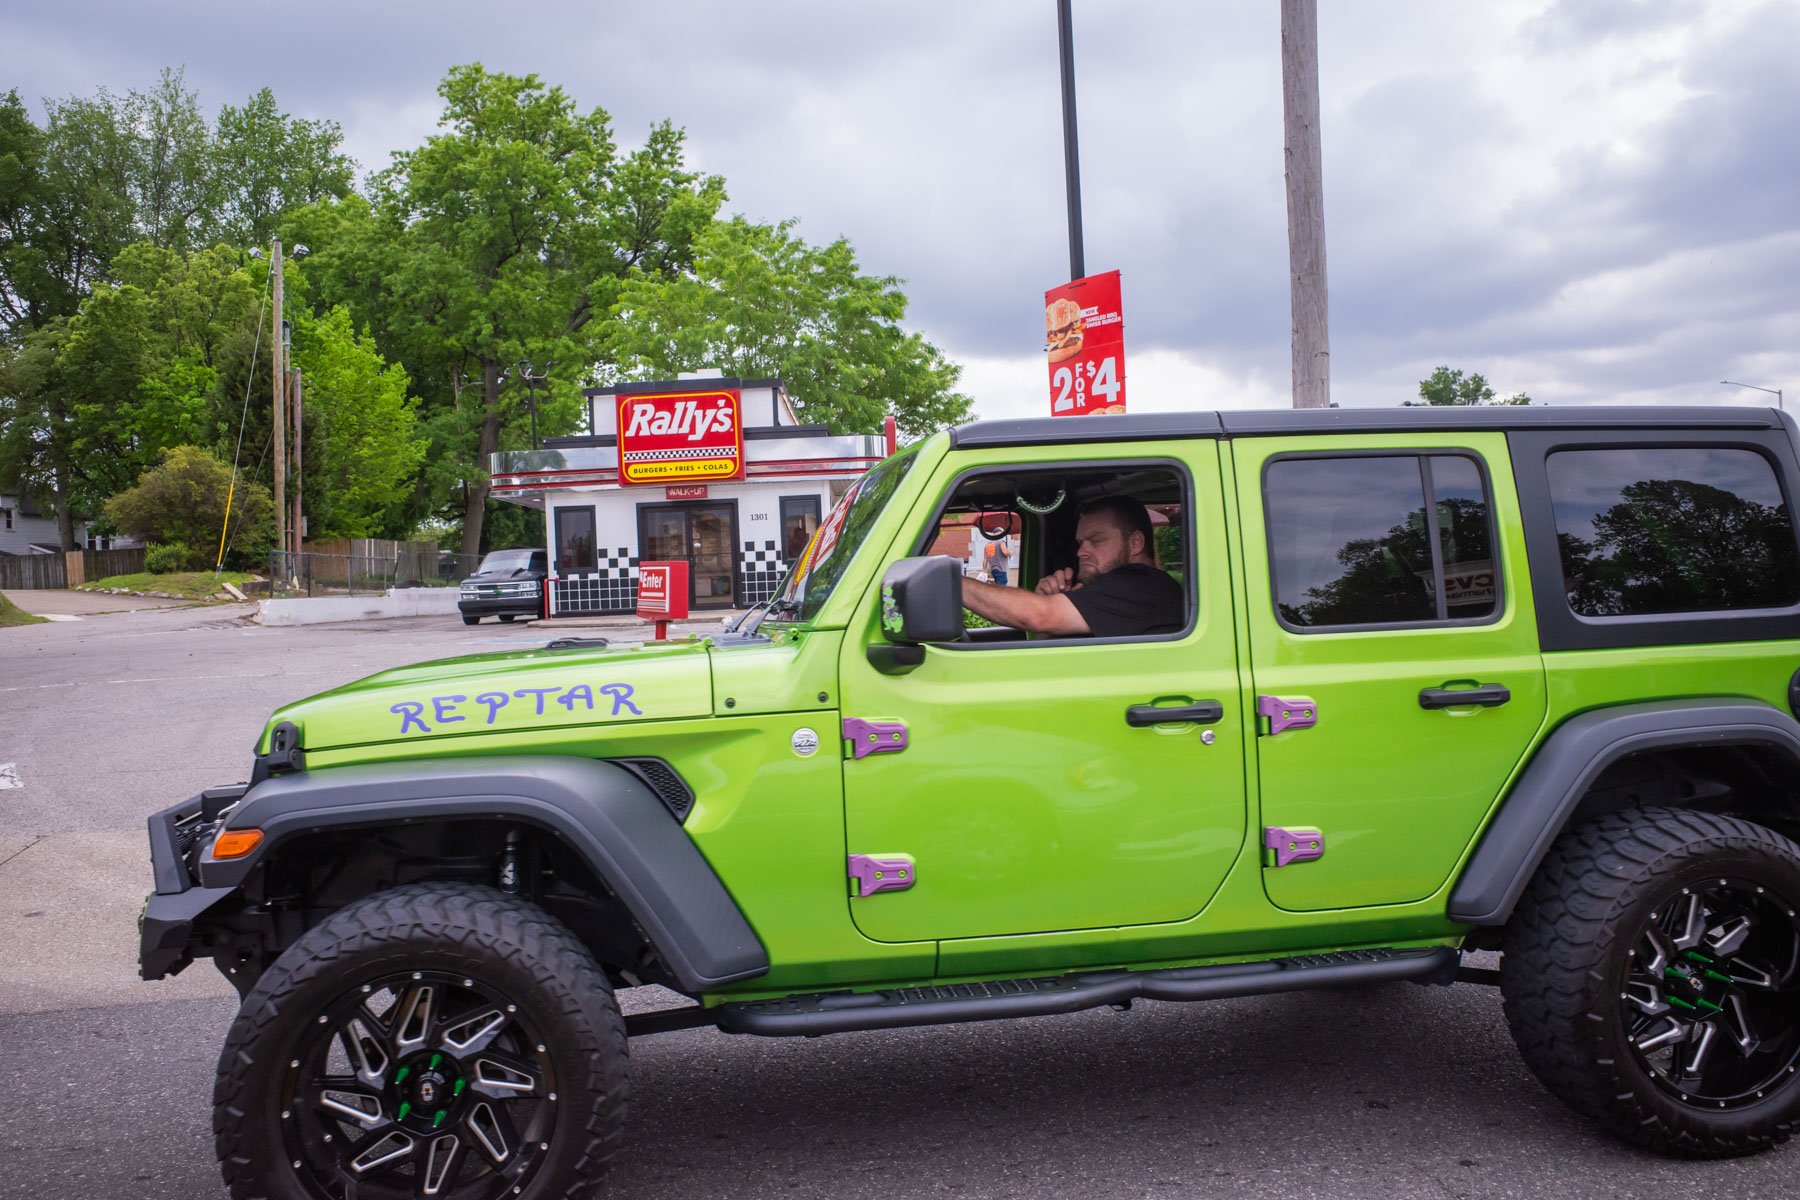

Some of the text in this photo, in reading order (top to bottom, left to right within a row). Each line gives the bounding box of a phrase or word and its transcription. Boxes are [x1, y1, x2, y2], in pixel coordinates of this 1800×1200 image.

[1053, 356, 1121, 413] 2 FOR $4
[625, 399, 734, 441] Rally's
[633, 466, 667, 474] BURGERS
[703, 463, 729, 471] COLAS
[668, 487, 705, 496] WALK-UP
[750, 513, 768, 521] 1301
[642, 571, 663, 589] Enter
[390, 682, 643, 735] REPTAR
